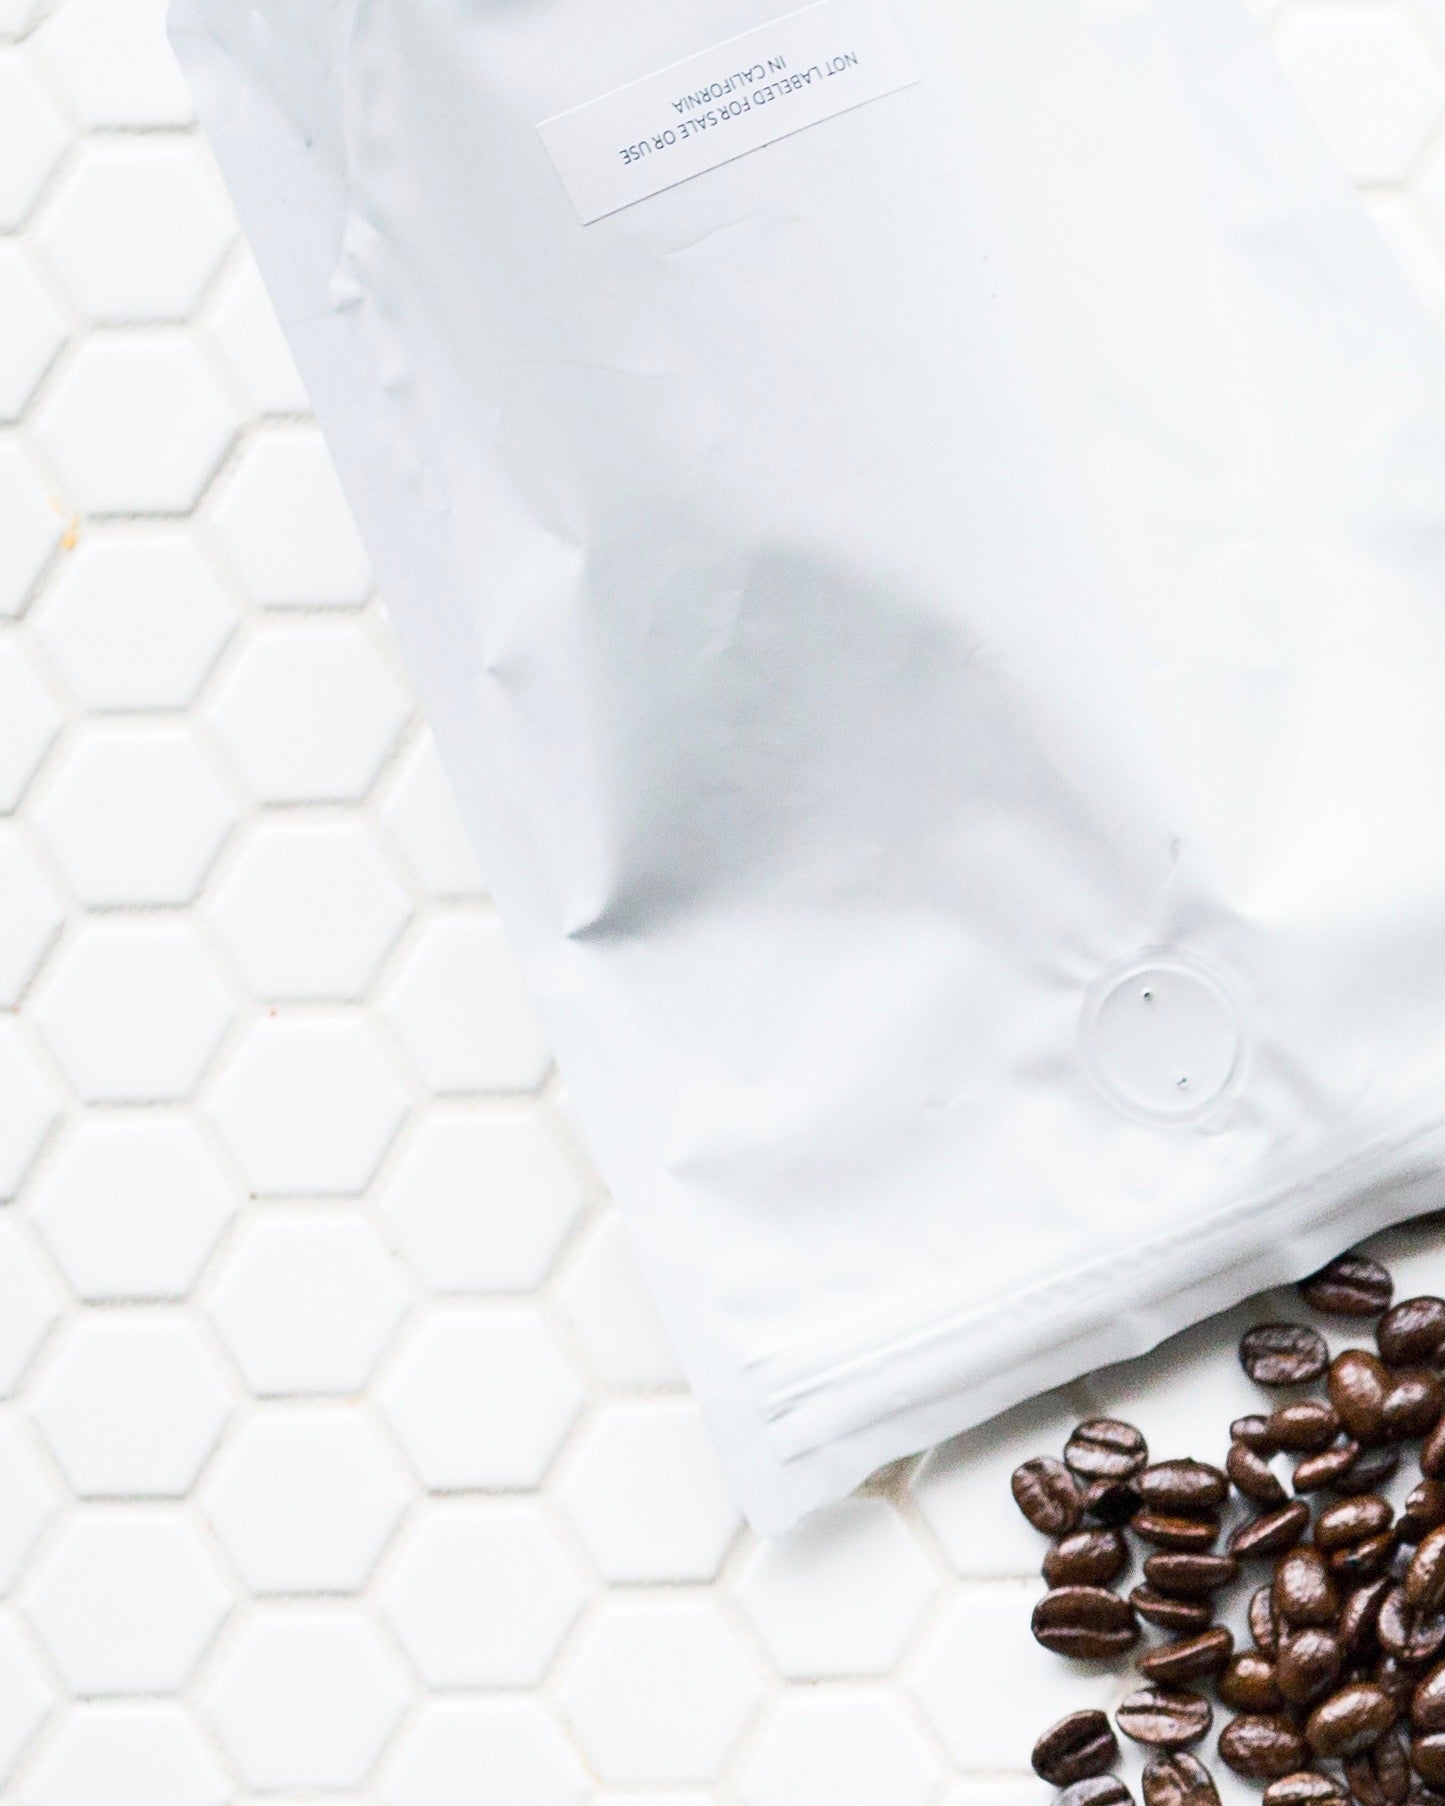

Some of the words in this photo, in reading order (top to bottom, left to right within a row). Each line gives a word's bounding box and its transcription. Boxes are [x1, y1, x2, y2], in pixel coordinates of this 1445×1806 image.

[766, 55, 787, 75] IN
[826, 51, 860, 77] NOT
[671, 64, 766, 114] CALIFORNIA
[752, 66, 823, 106] LABELED
[718, 96, 752, 121] FOR
[678, 111, 718, 140] SALE
[619, 139, 652, 165] USE
[651, 130, 677, 150] OR
